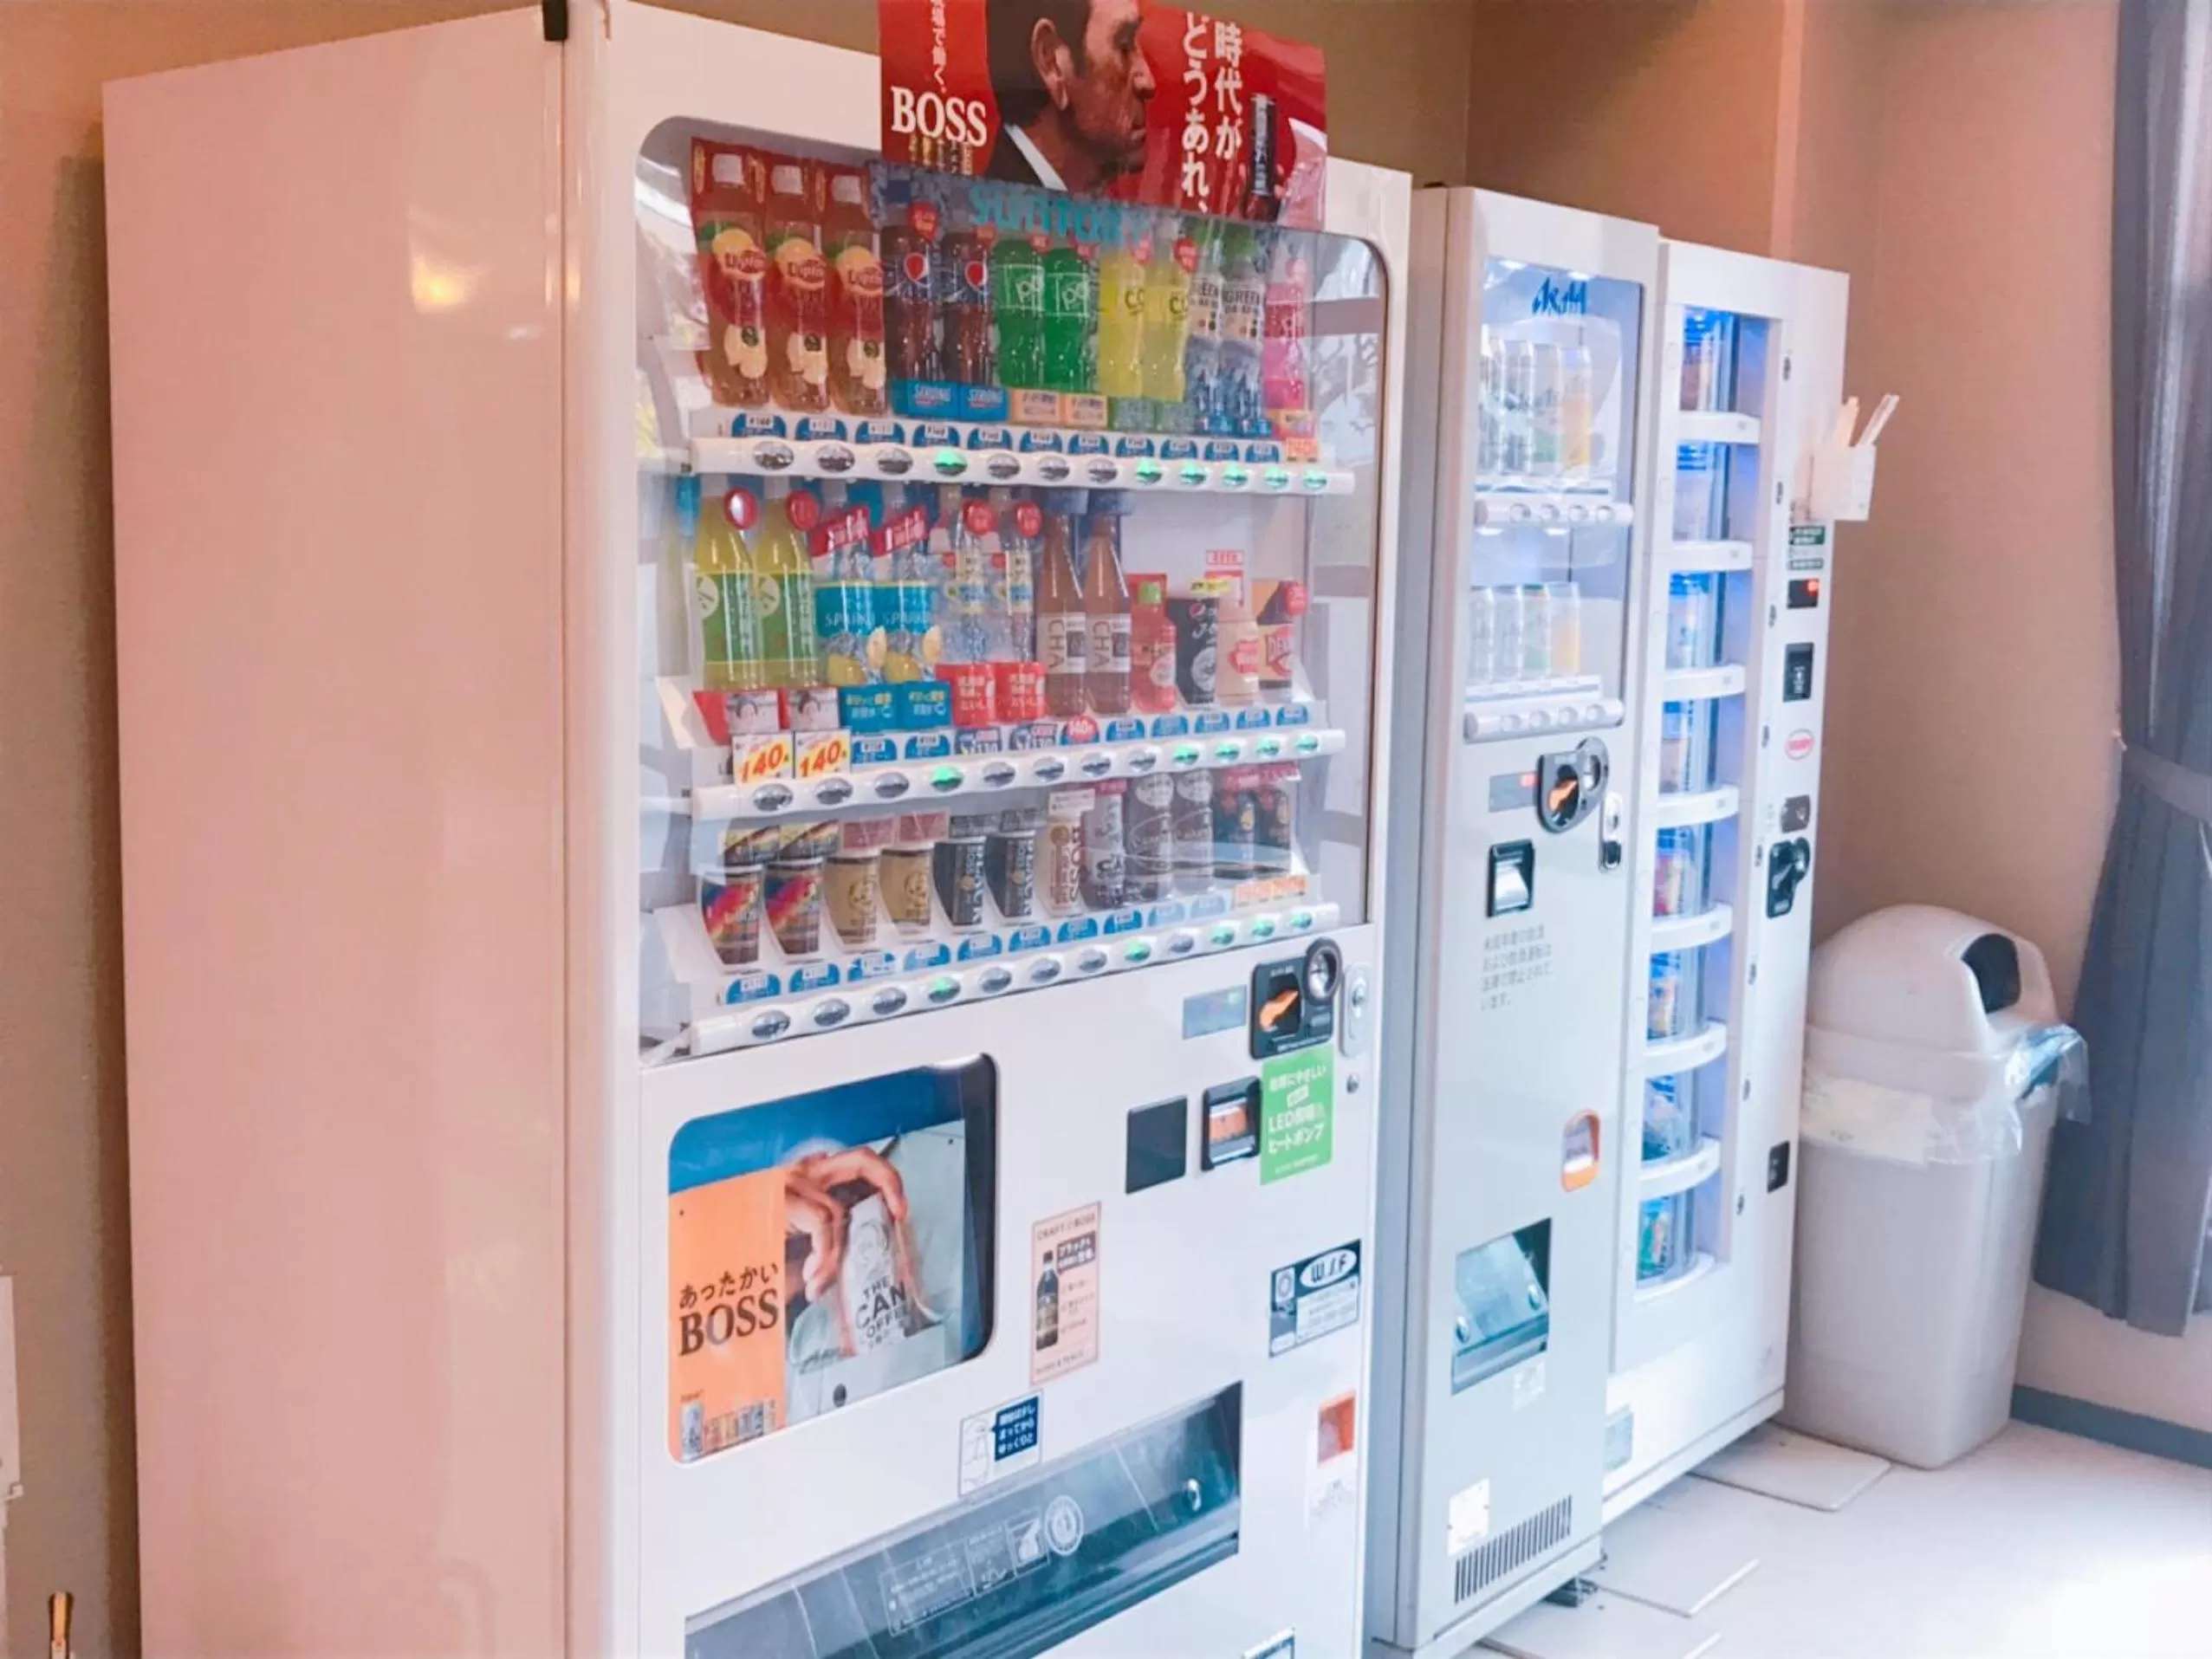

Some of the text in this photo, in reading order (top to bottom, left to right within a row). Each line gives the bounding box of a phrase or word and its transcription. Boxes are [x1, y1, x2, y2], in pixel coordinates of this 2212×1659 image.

[891, 85, 987, 147] BOSS
[1182, 11, 1210, 214] どうあれ、
[1214, 21, 1242, 160] 時代が
[1048, 619, 1066, 669] CHA
[1093, 621, 1111, 668] CHA
[679, 1262, 778, 1309] あったかい
[678, 1287, 779, 1357] BOSS
